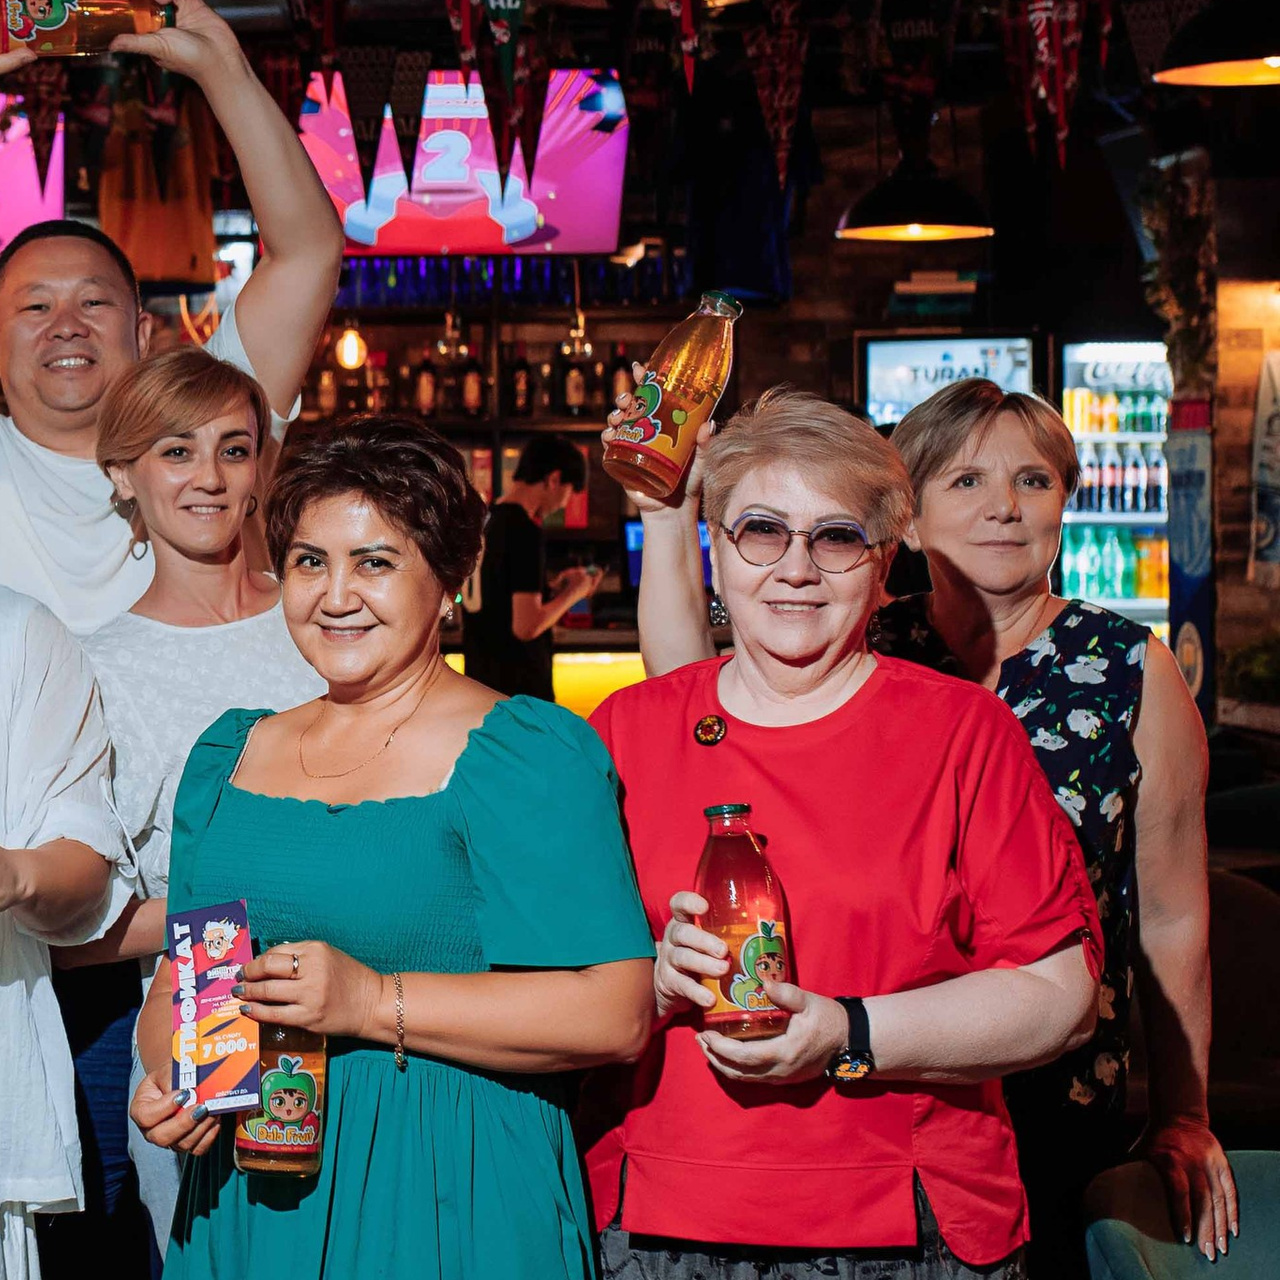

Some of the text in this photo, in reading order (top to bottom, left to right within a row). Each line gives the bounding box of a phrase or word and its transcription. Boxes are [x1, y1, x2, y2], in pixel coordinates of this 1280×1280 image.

[422, 129, 471, 183] 2
[257, 1125, 314, 1144] Dala Fruit
